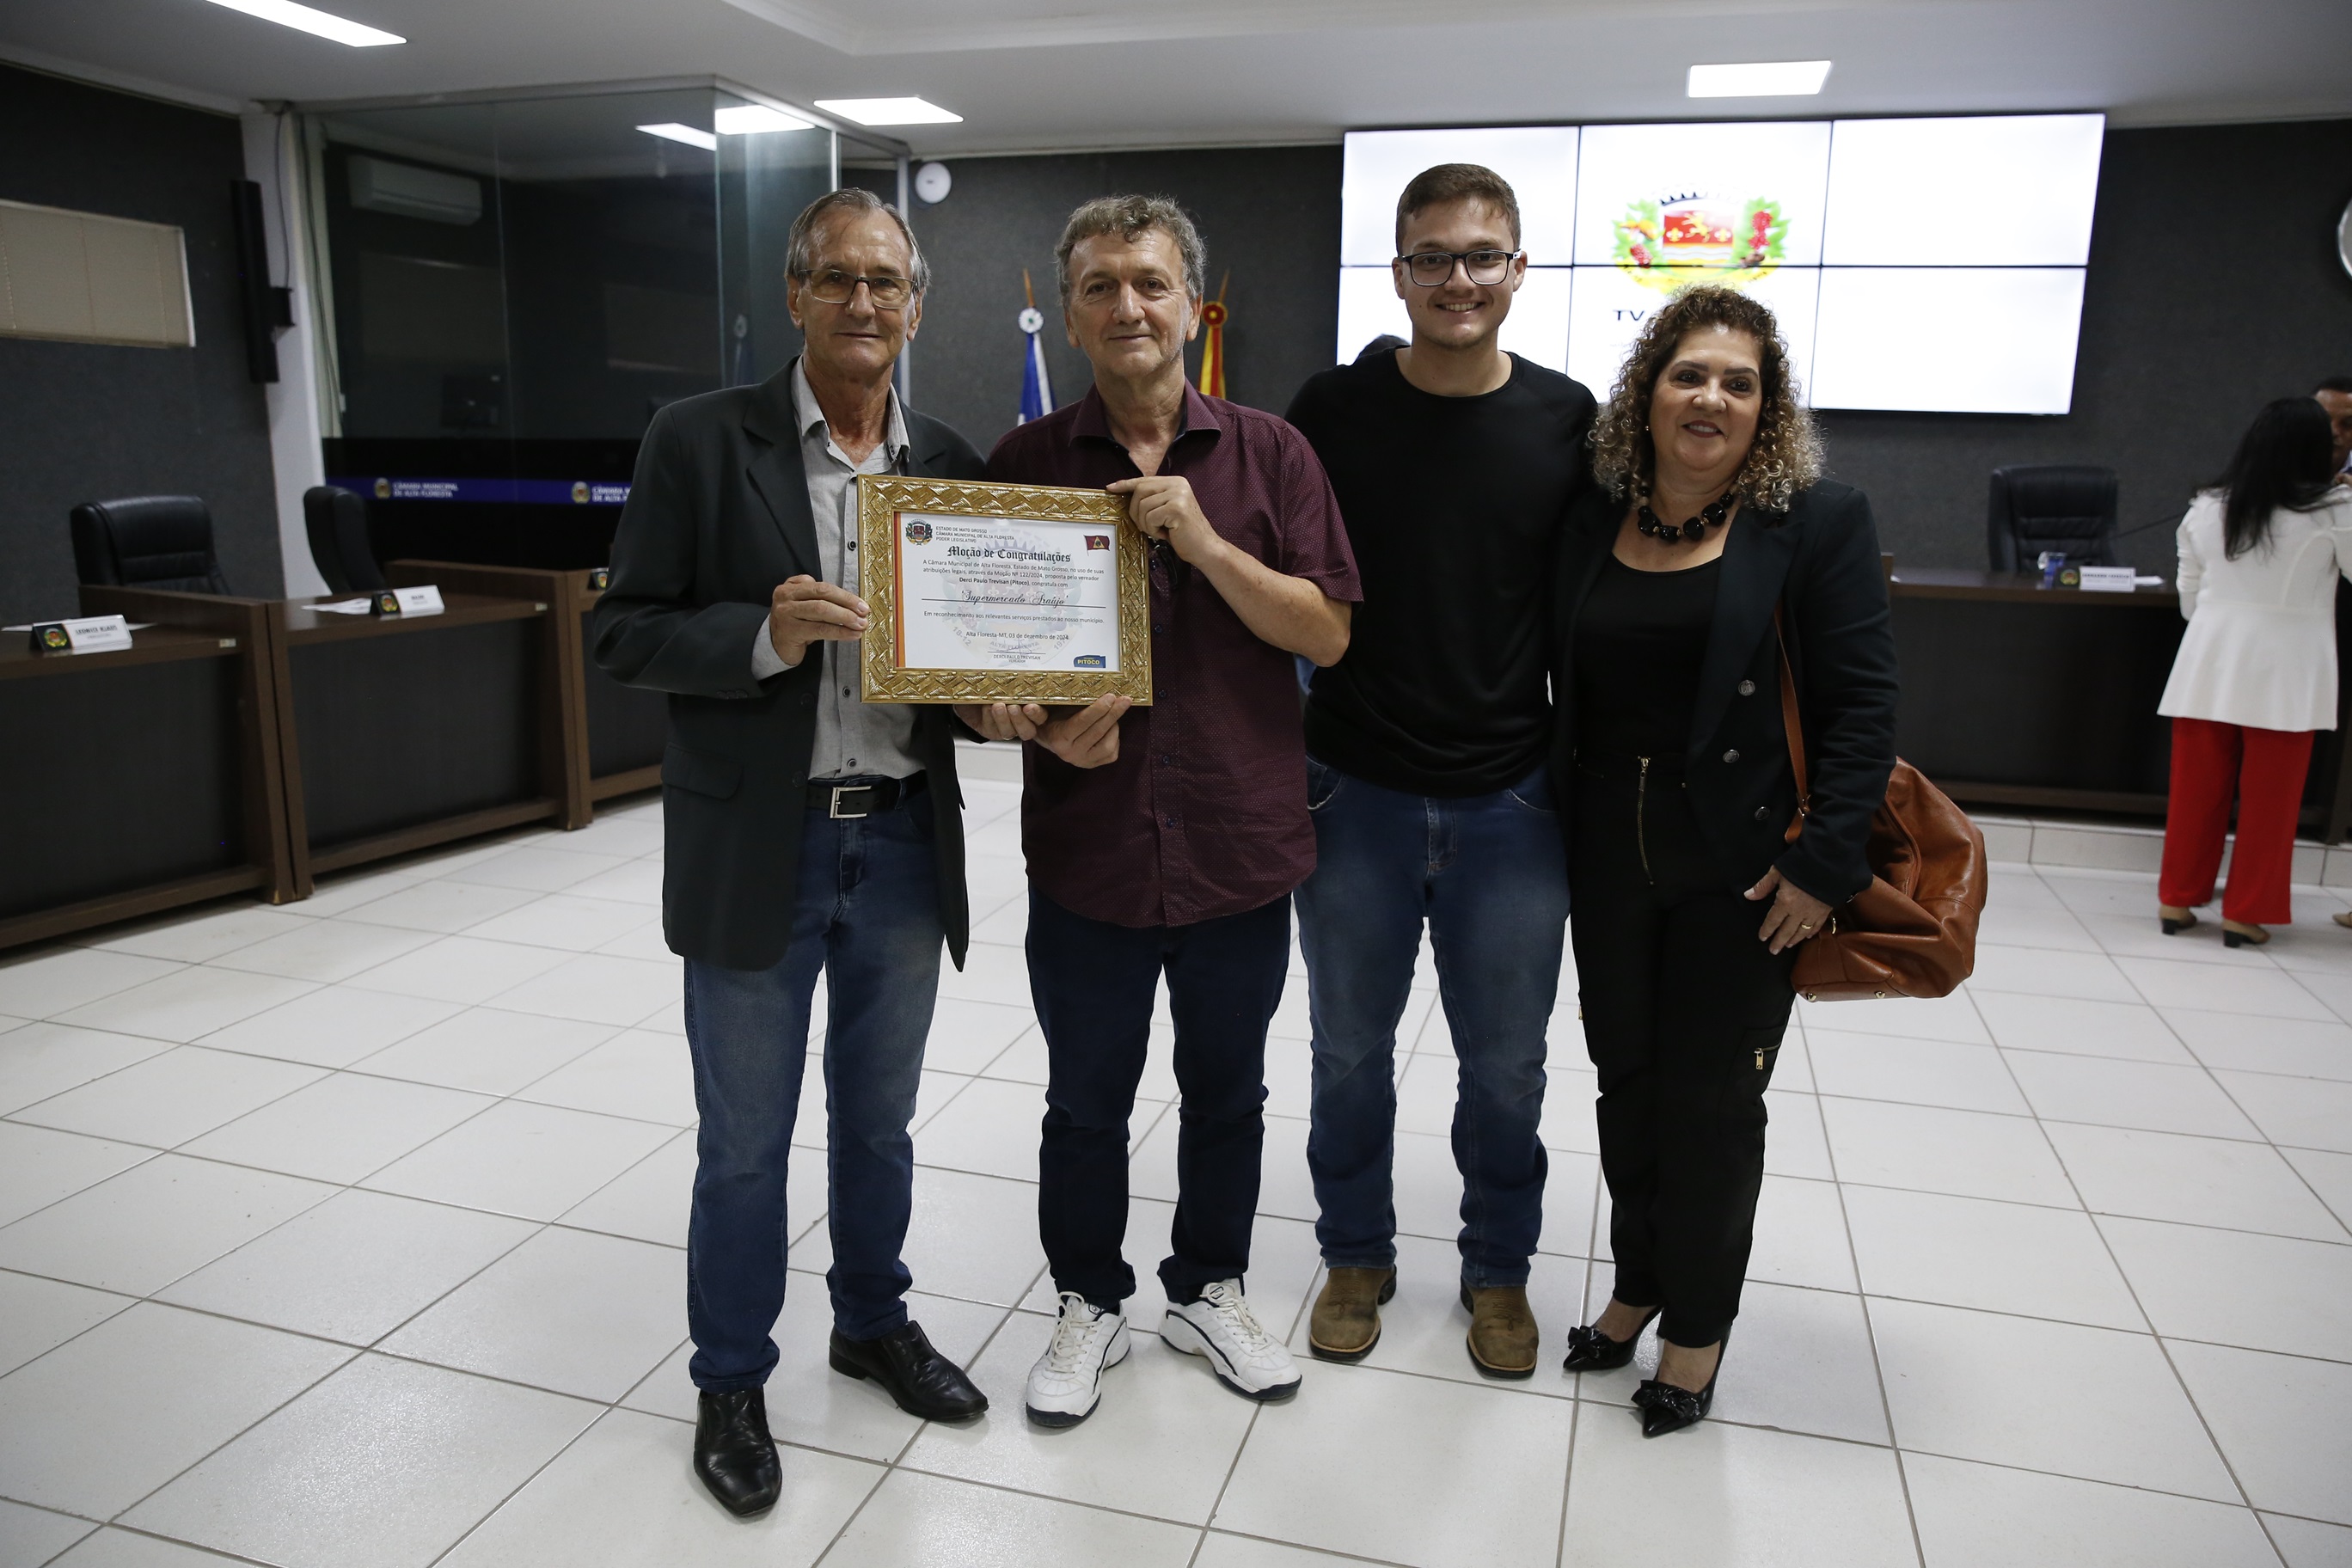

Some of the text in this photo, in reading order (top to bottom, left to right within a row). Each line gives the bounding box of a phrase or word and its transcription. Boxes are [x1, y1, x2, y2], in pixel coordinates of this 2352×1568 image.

[1613, 309, 1645, 322] TV
[947, 546, 1071, 564] Moção de Congratulações
